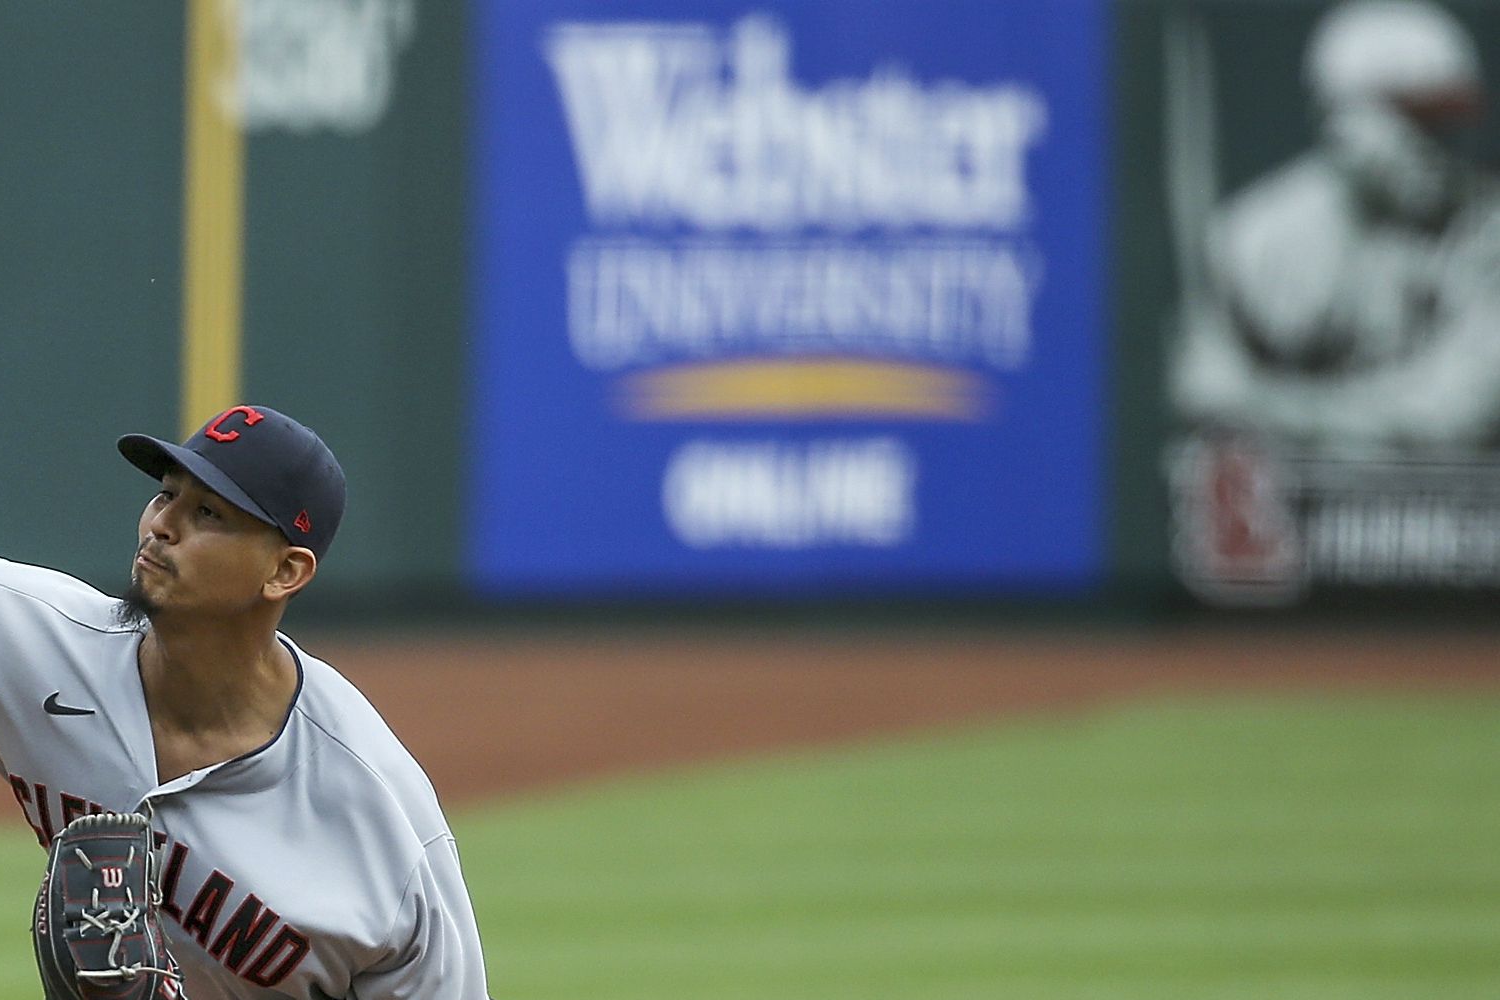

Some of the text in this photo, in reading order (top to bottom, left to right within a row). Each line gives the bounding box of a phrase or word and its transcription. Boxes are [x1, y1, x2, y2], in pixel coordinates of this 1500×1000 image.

[546, 12, 1046, 230] Webster
[564, 238, 1042, 370] UNIVERSITY
[205, 405, 263, 442] C
